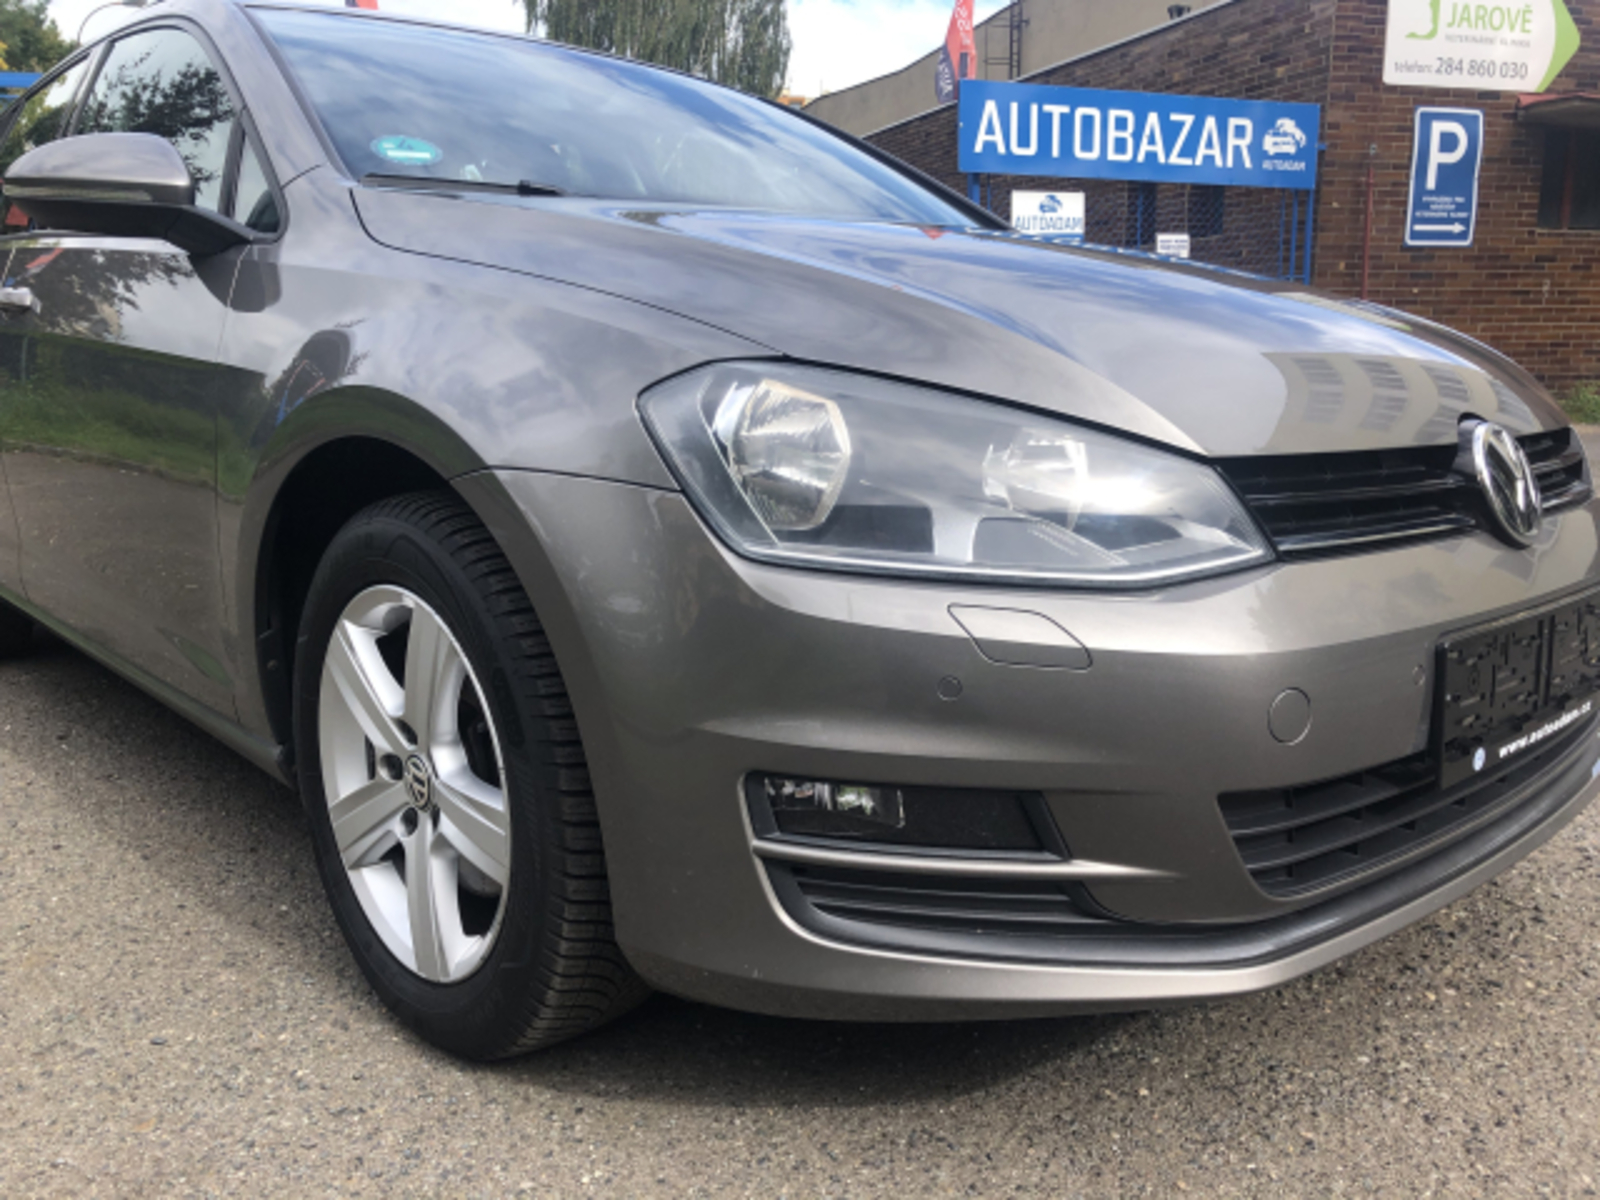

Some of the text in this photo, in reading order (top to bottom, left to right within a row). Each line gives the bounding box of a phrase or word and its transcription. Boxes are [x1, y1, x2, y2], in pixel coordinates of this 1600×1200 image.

[1447, 3, 1532, 33] JAROVĚ
[1435, 57, 1463, 75] 284
[1467, 59, 1496, 78] 860
[1500, 61, 1528, 79] 030
[974, 99, 1253, 169] AUTOBAZAR
[1426, 120, 1468, 190] P
